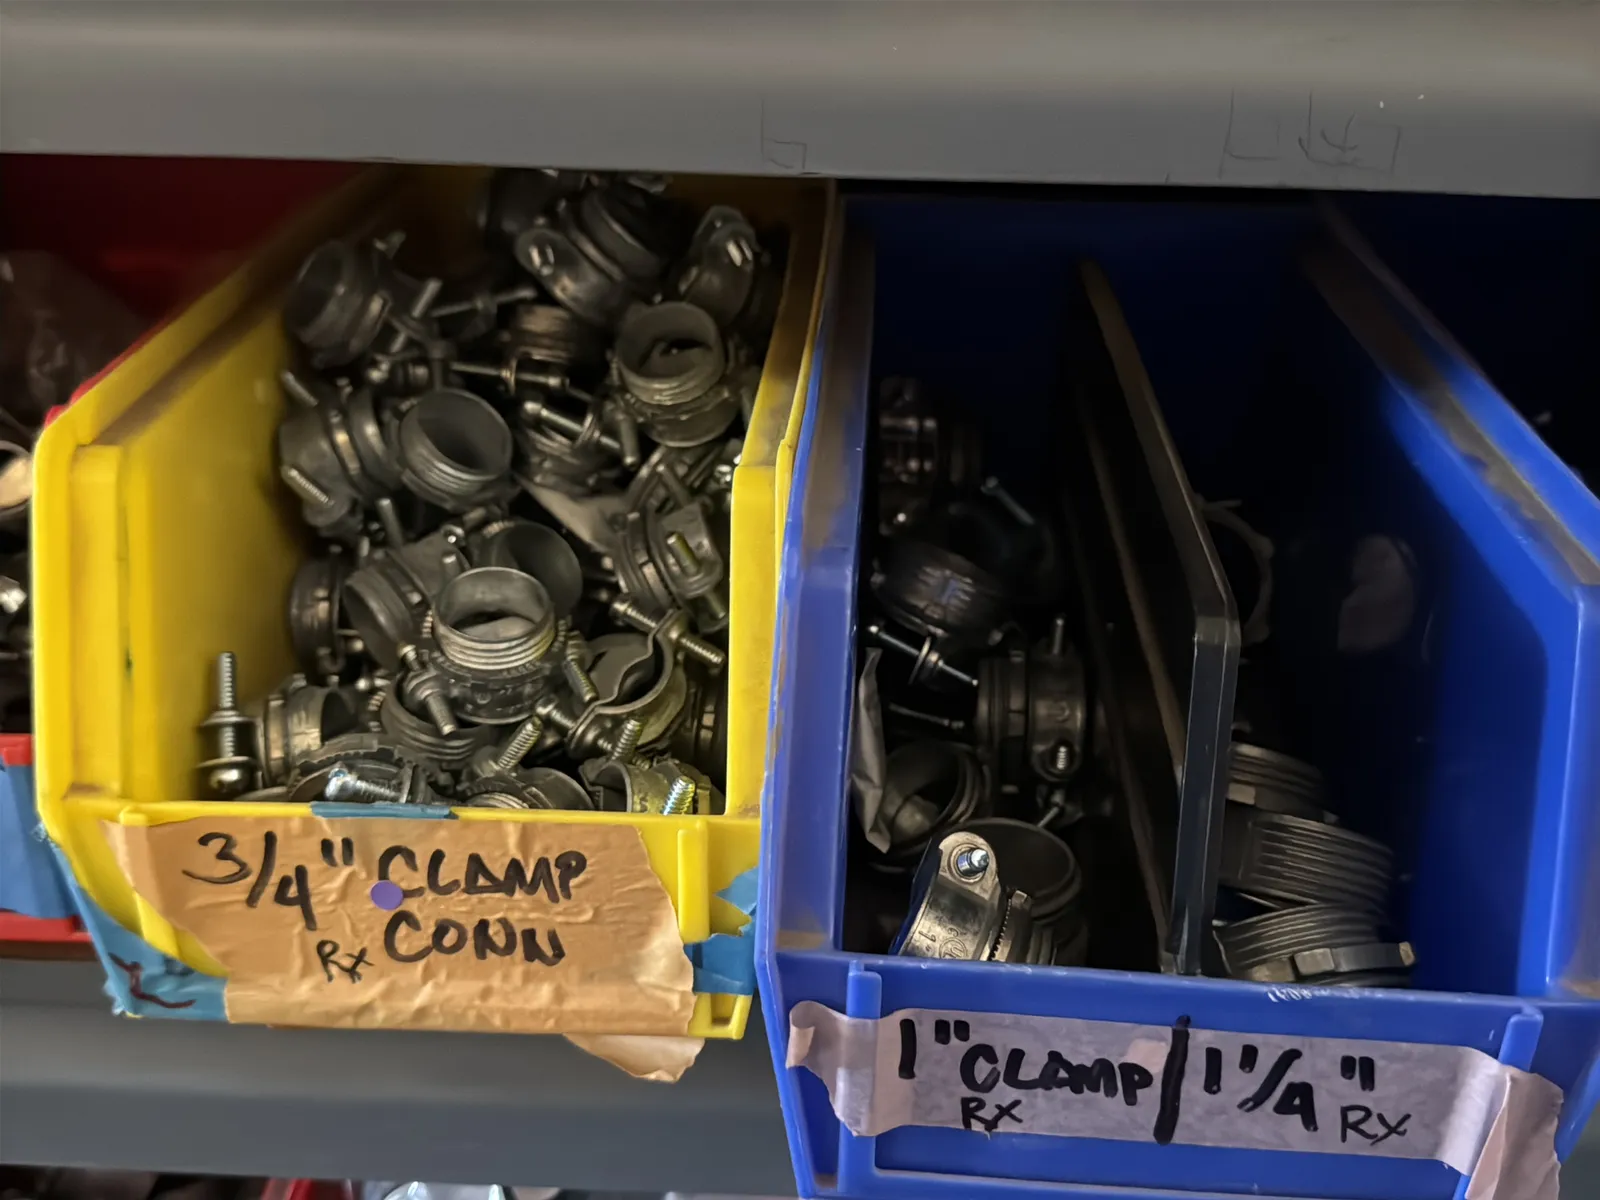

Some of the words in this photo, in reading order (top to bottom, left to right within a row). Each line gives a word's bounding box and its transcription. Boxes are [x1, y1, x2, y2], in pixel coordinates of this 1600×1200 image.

[182, 830, 354, 931] 3/4"
[378, 844, 587, 904] CLAMP
[384, 910, 566, 967] CONN
[898, 1018, 970, 1080] 1"
[960, 1043, 1153, 1106] CLAMP
